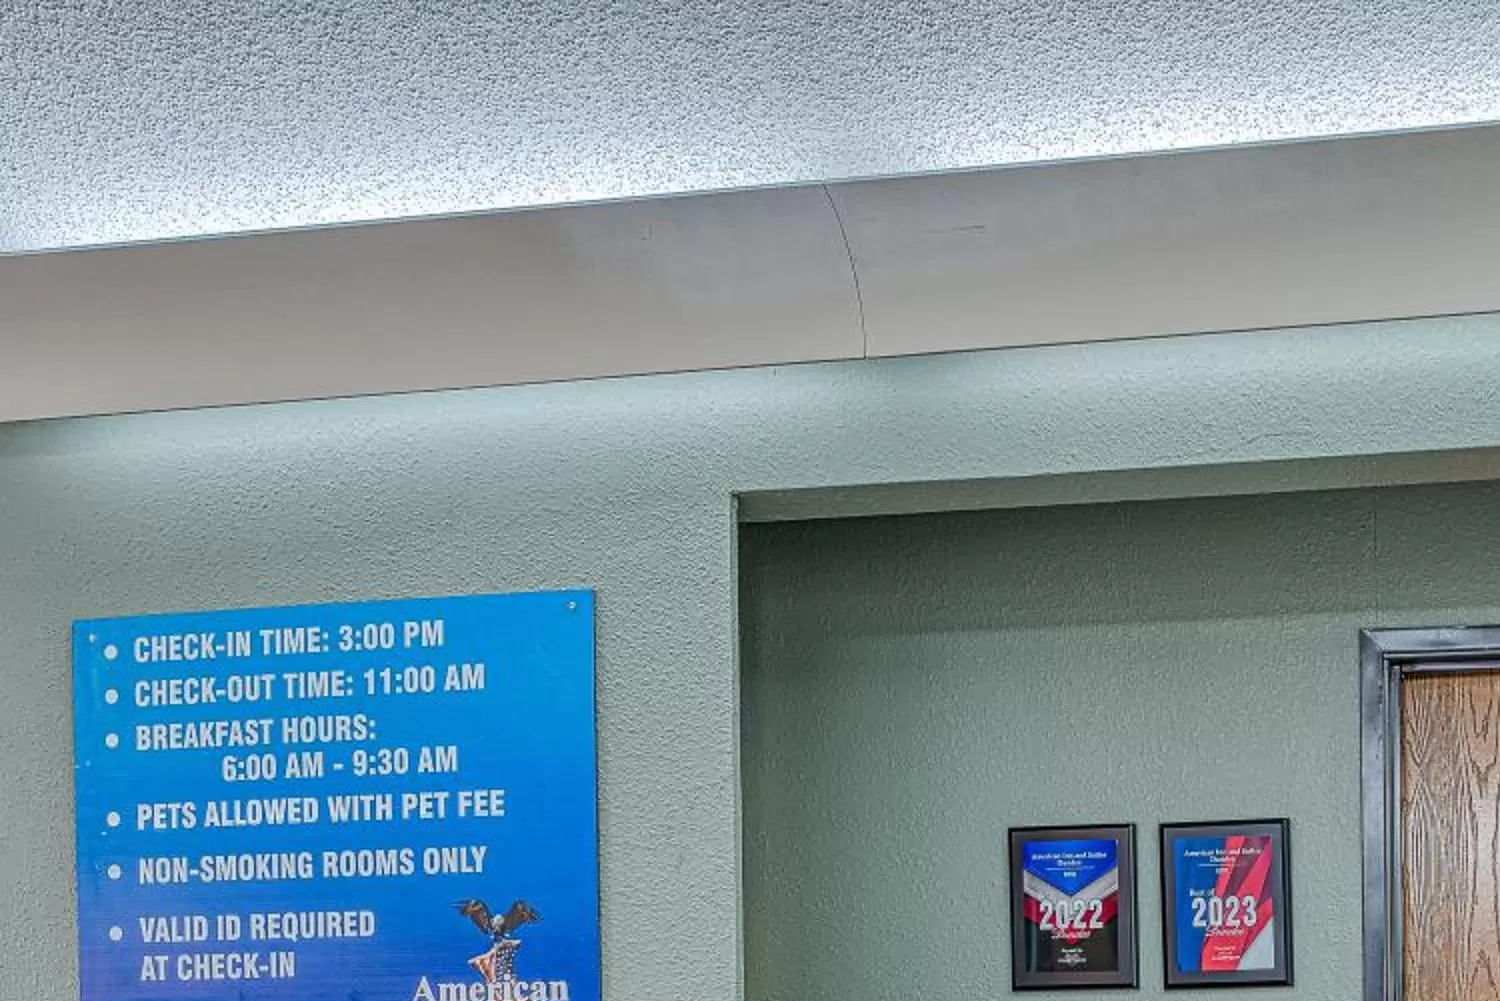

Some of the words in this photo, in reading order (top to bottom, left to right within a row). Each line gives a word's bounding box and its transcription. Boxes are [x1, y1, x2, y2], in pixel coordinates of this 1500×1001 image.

[134, 631, 252, 663] CHECK-IN
[259, 626, 329, 656] TIME:
[338, 622, 395, 652] 3:00
[403, 619, 445, 648] PM
[135, 673, 277, 707] CHECK-OUT
[283, 670, 353, 700] TIME:
[363, 665, 435, 695] 11:00
[444, 663, 486, 691] AM
[136, 719, 274, 751] BREAKFAST
[282, 714, 376, 744] HOURS:
[222, 754, 277, 782] 6:00
[284, 751, 325, 779] AM
[353, 747, 410, 776] 9:30
[417, 745, 459, 773] AM
[137, 801, 197, 831] PETS
[204, 797, 320, 828] ALLOWED
[328, 793, 393, 824] WITH
[402, 791, 449, 820] PET
[457, 789, 506, 817] FEE
[139, 851, 313, 885] NON-SMOKING
[322, 847, 415, 878] ROOMS
[423, 845, 488, 875] ONLY
[139, 915, 209, 944] VALID
[217, 914, 241, 942] ID
[250, 910, 376, 943] REQUIRED
[1039, 899, 1104, 931] 2022
[1191, 895, 1257, 927] 2023
[140, 954, 169, 982] AT
[177, 951, 296, 981] CHECK-IN
